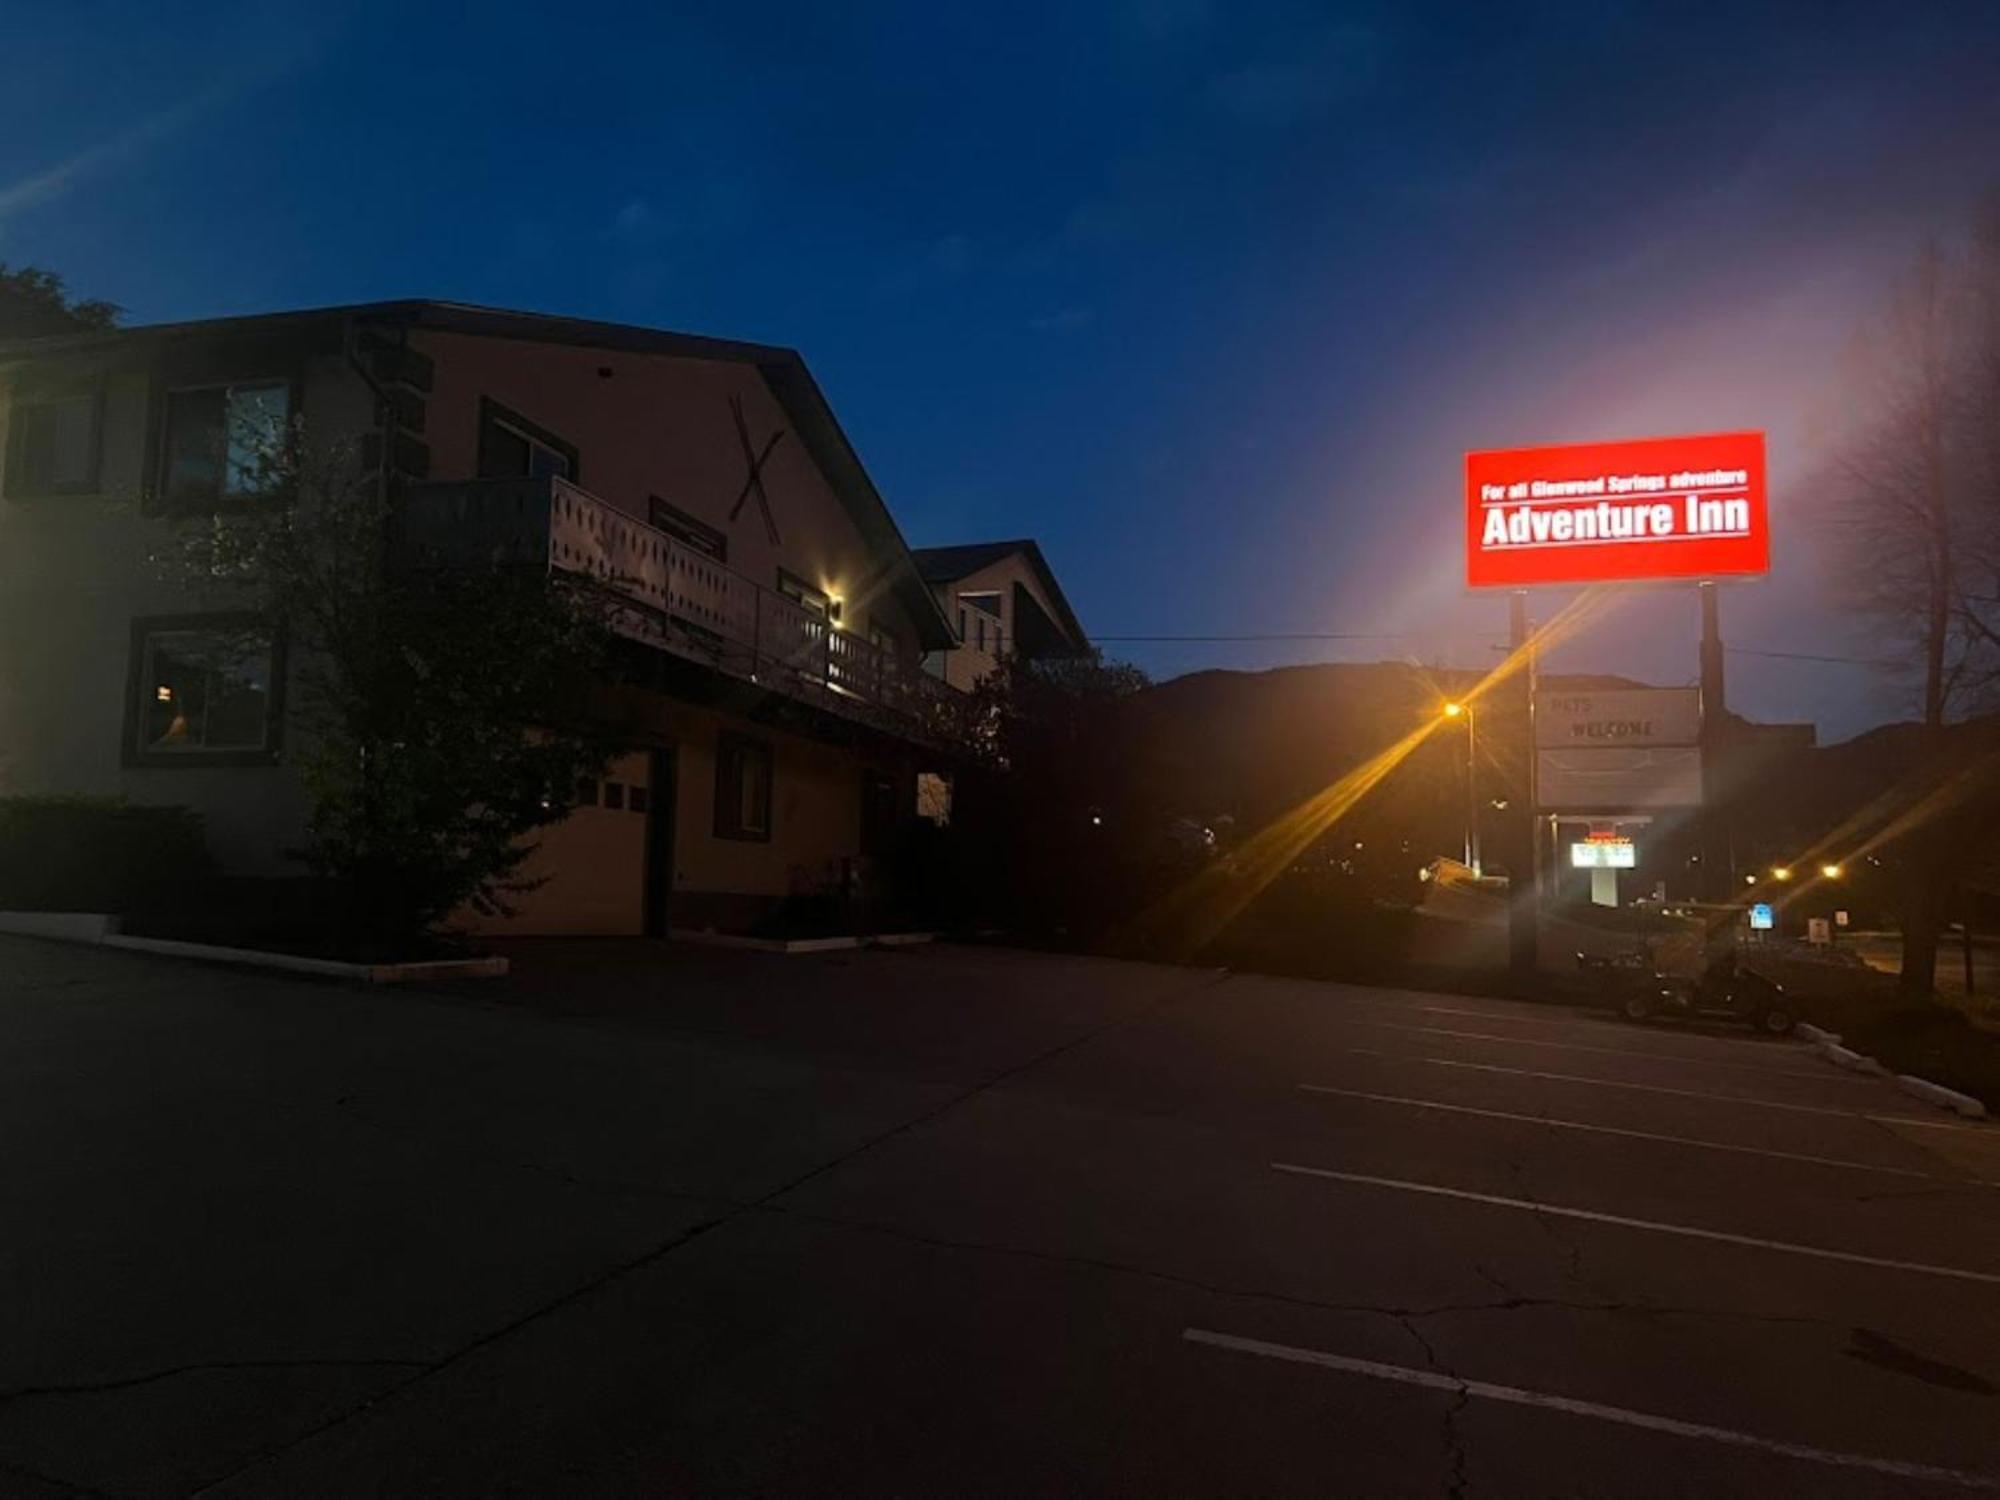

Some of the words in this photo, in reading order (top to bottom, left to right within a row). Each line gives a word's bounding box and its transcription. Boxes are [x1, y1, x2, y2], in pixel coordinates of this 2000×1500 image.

[1482, 484, 1505, 501] For
[1509, 481, 1527, 499] all
[1531, 477, 1605, 497] Glenwood
[1608, 473, 1665, 495] Springs
[1670, 469, 1747, 489] adventure
[1484, 502, 1673, 544] Adventure
[1686, 495, 1749, 533] Inn
[1572, 721, 1654, 737] WELCOME
